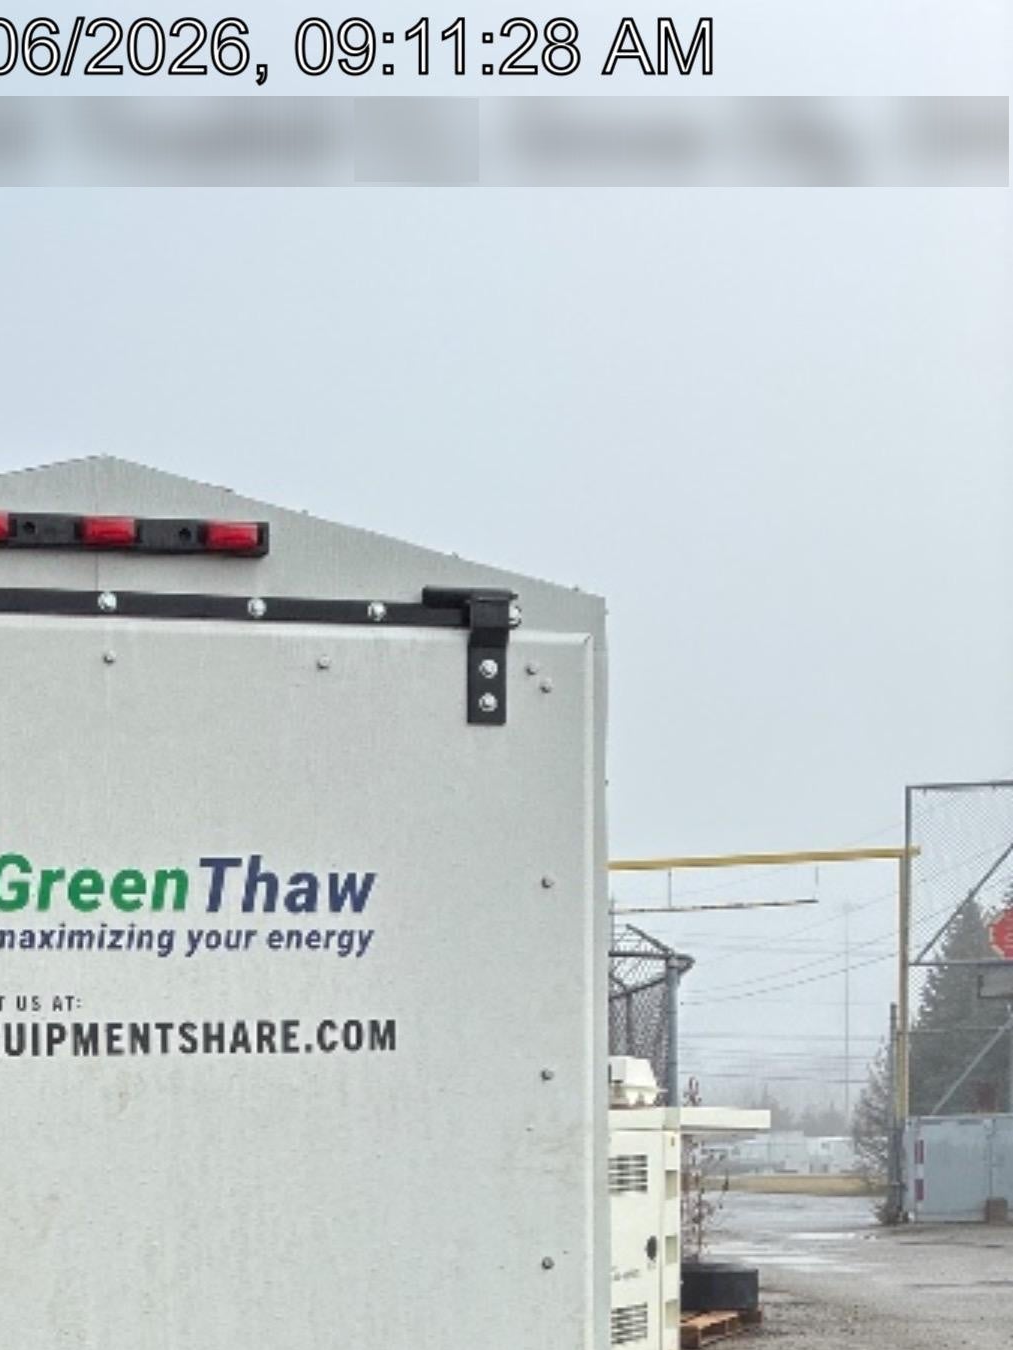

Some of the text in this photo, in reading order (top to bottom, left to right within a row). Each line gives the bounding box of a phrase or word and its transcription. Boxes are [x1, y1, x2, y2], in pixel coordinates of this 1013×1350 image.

[185, 929, 258, 958] your
[266, 929, 375, 958] energy
[15, 994, 43, 1012] US
[51, 994, 84, 1012] AT:
